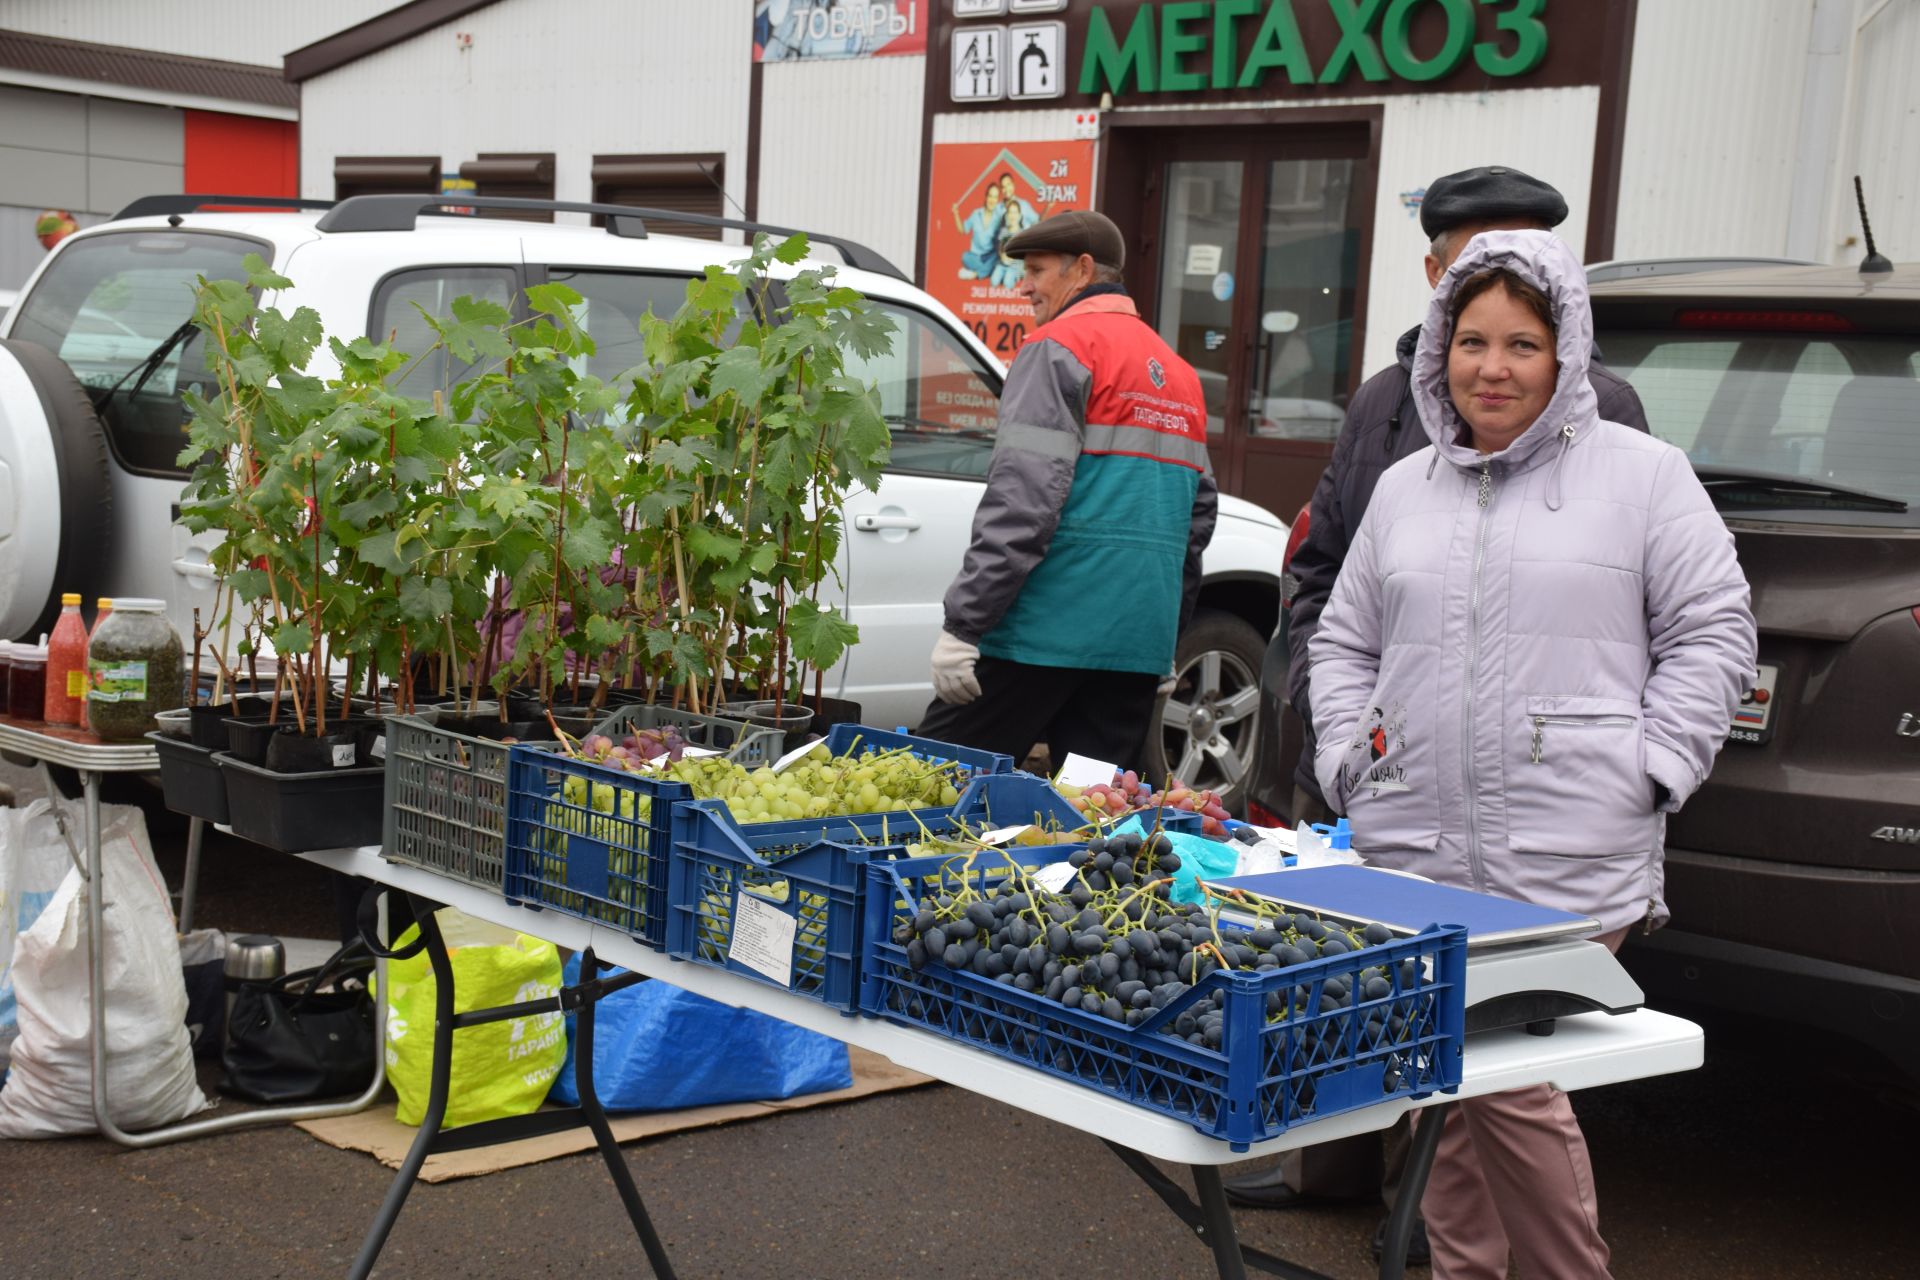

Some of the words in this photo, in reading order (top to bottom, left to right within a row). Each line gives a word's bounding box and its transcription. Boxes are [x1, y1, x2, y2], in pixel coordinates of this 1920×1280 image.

[793, 1, 916, 41] ТОВАРЫ
[1036, 185, 1077, 202] ЭТАЖ
[962, 302, 997, 314] РЕЖИМ
